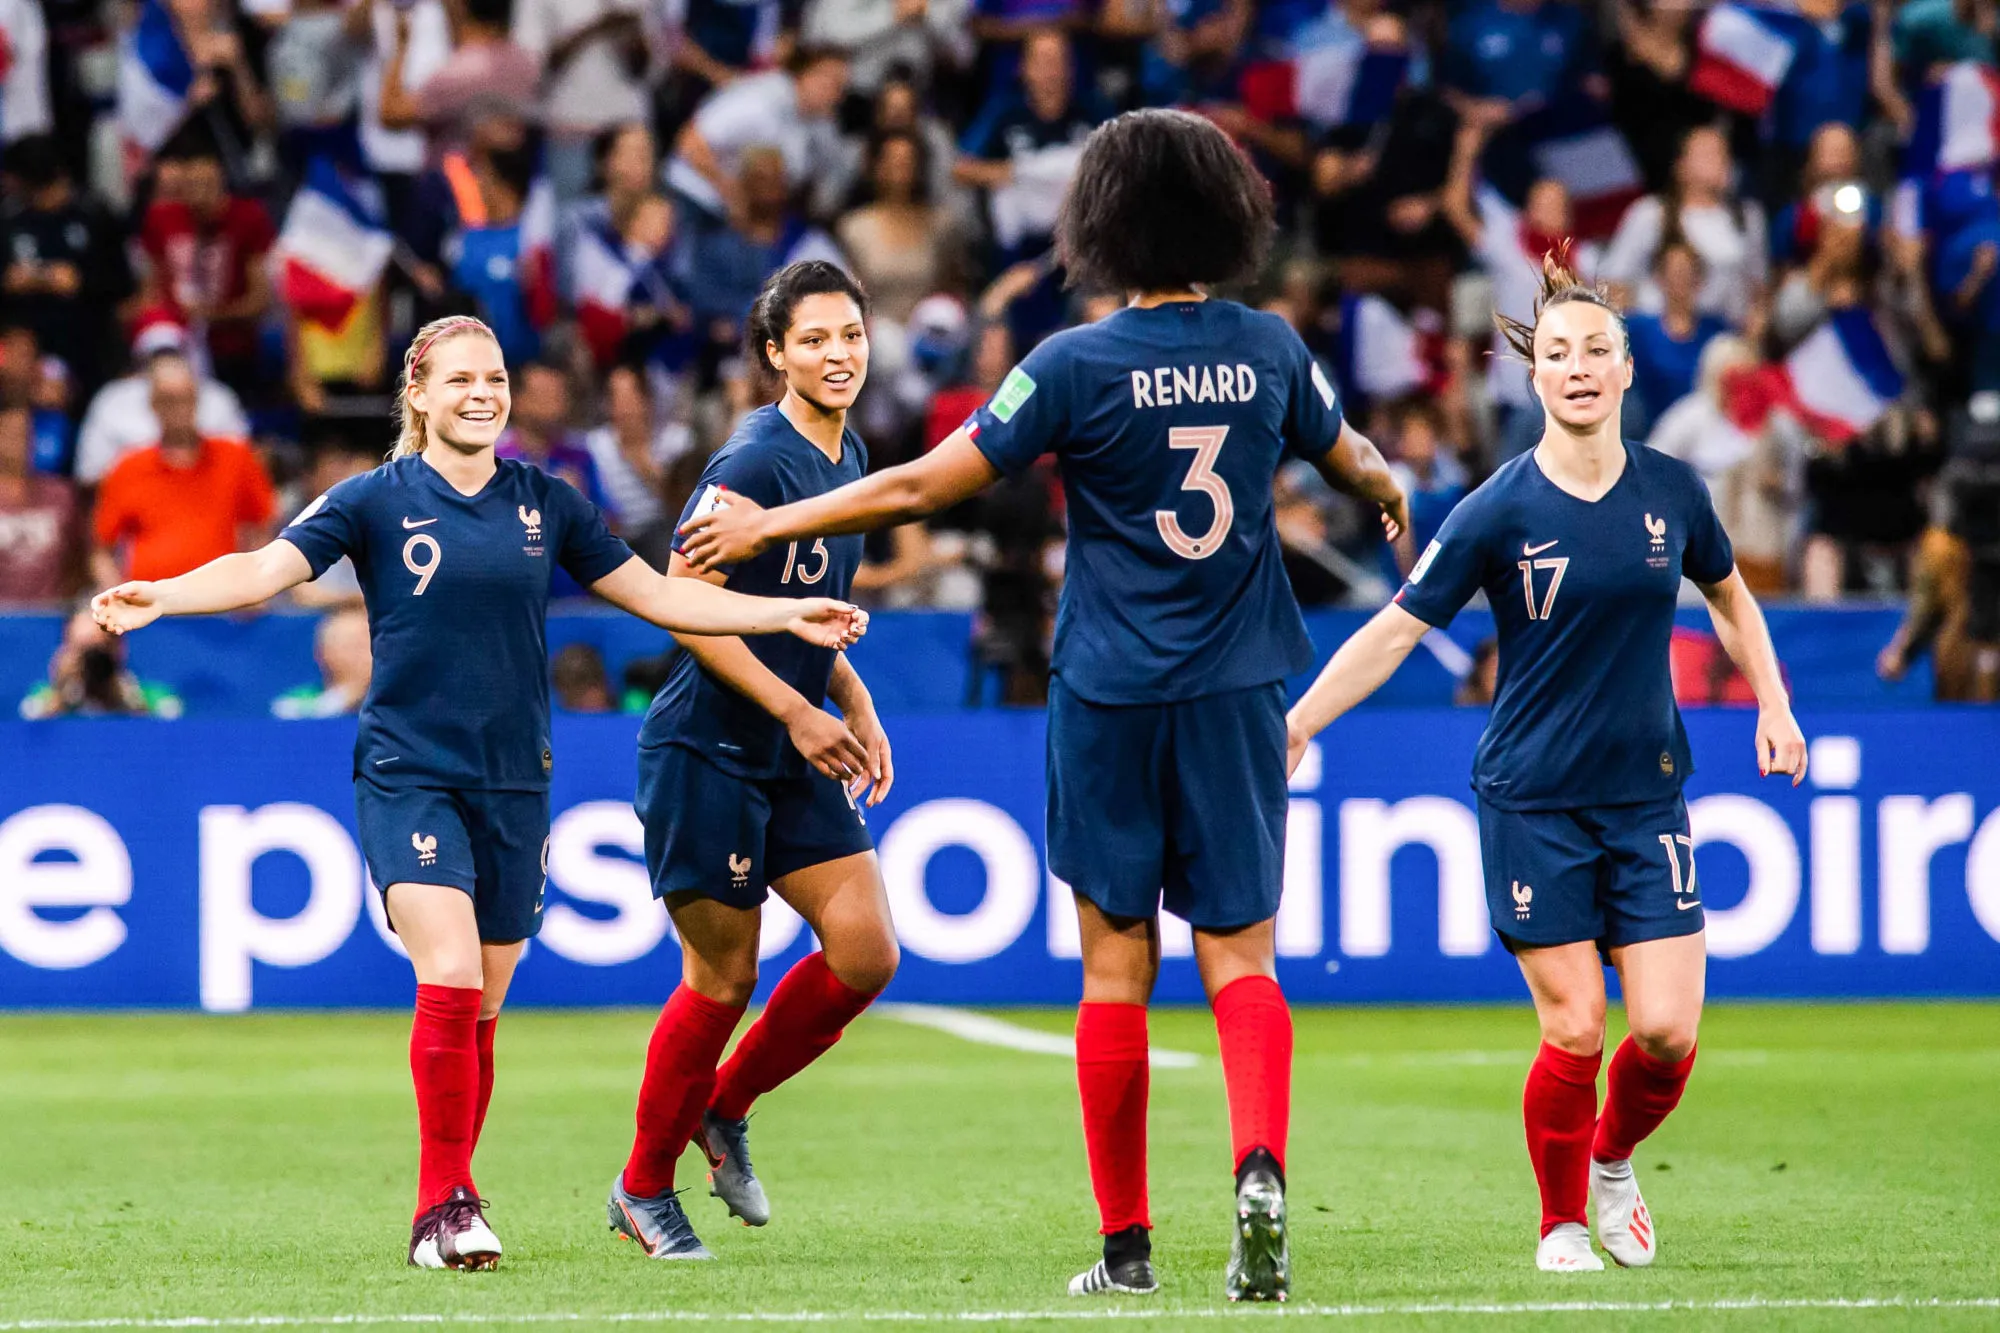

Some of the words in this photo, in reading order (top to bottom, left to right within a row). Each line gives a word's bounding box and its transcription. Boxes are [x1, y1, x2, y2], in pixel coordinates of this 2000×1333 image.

[1131, 363, 1257, 409] RENARD
[1155, 425, 1234, 560] 3
[402, 533, 441, 596] 9
[780, 537, 829, 585] 13
[1517, 557, 1570, 620] 17
[0, 803, 134, 968] e
